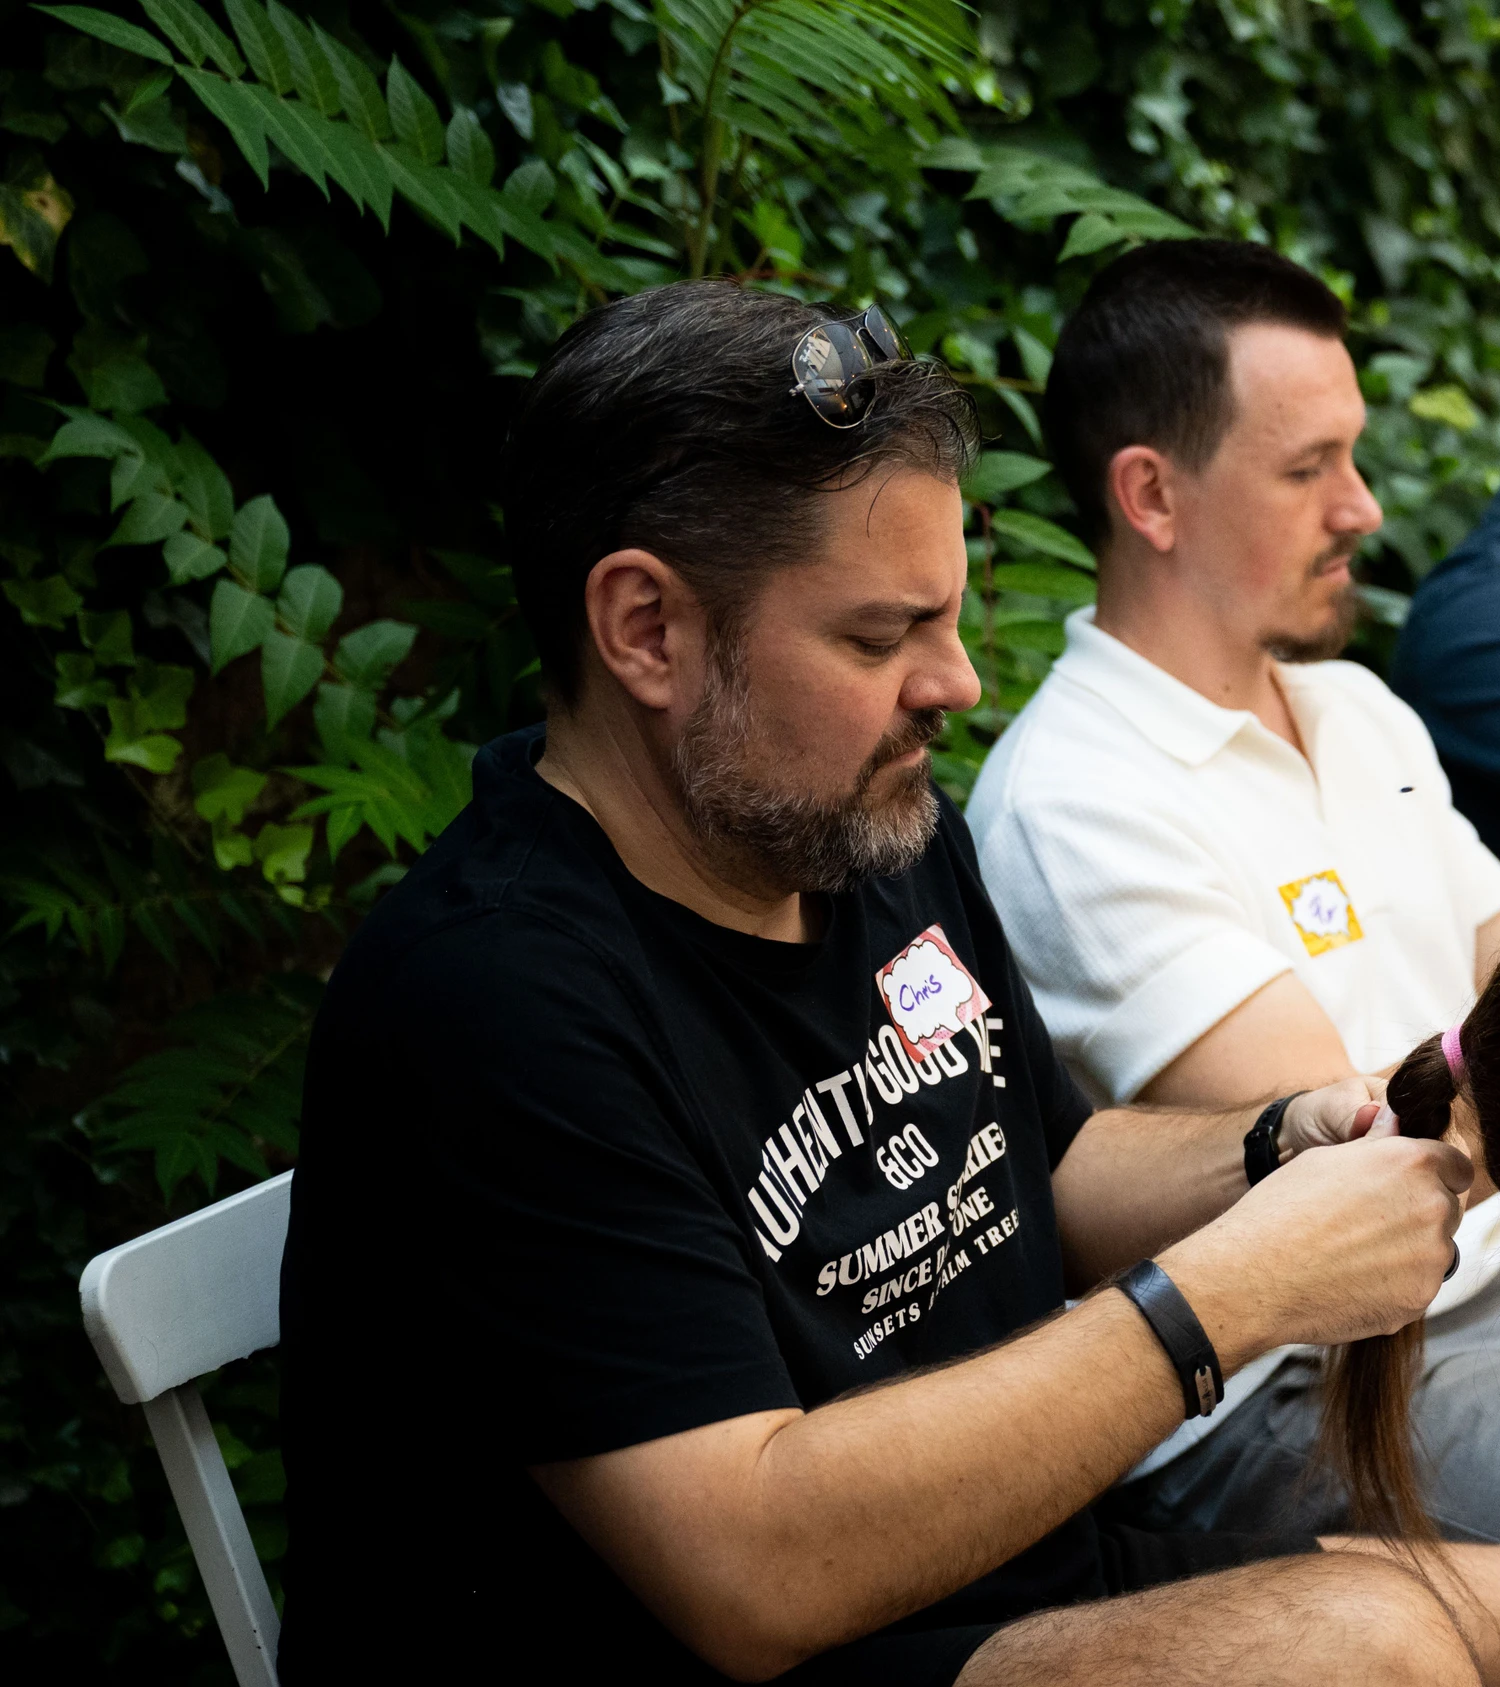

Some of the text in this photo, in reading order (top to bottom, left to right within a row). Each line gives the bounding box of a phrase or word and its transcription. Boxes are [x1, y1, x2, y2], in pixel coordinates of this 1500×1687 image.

[899, 973, 943, 1012] Chris
[876, 1122, 940, 1191] &CO
[815, 1201, 946, 1296] SUMMER
[853, 1302, 922, 1361] SUNSETS
[935, 1248, 973, 1297] ALM
[861, 1256, 933, 1315] SINCE
